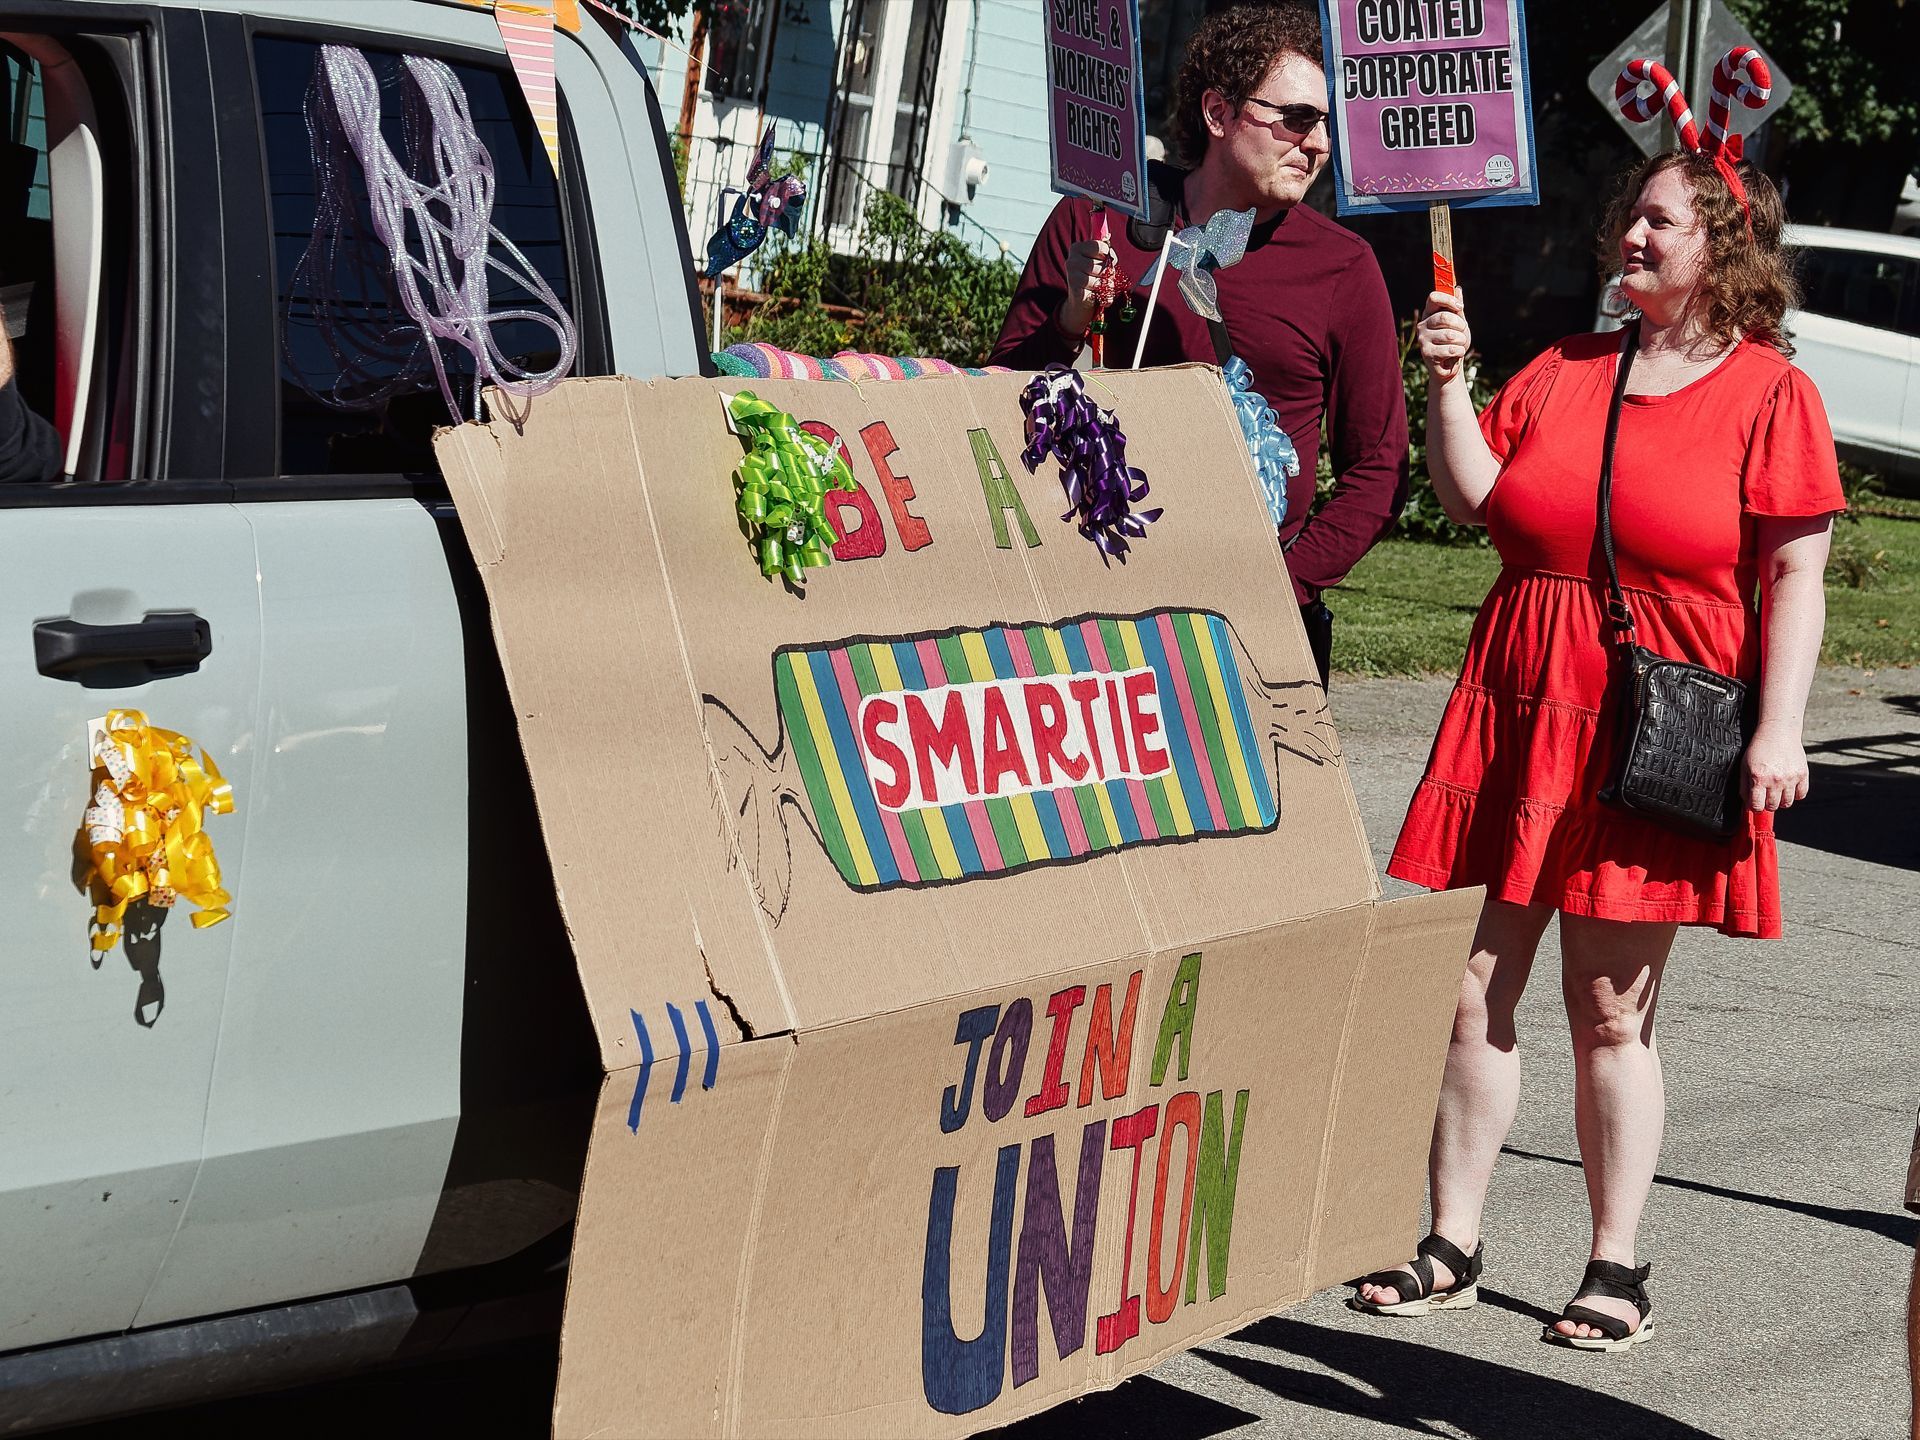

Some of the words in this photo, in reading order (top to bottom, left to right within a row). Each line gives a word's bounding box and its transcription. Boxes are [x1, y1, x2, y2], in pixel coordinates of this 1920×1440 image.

[1054, 0, 1106, 50] SPICE,
[1109, 5, 1123, 50] &
[1357, 0, 1486, 45] COATED
[1342, 49, 1514, 101] CORPORATE
[1066, 100, 1123, 160] RIGHTS
[1380, 103, 1476, 150] GREED
[966, 428, 1043, 549] A
[862, 672, 1170, 808] SMARTIE
[940, 970, 1143, 1134] JOIN
[1149, 952, 1202, 1086] A
[922, 1089, 1250, 1415] UNION
